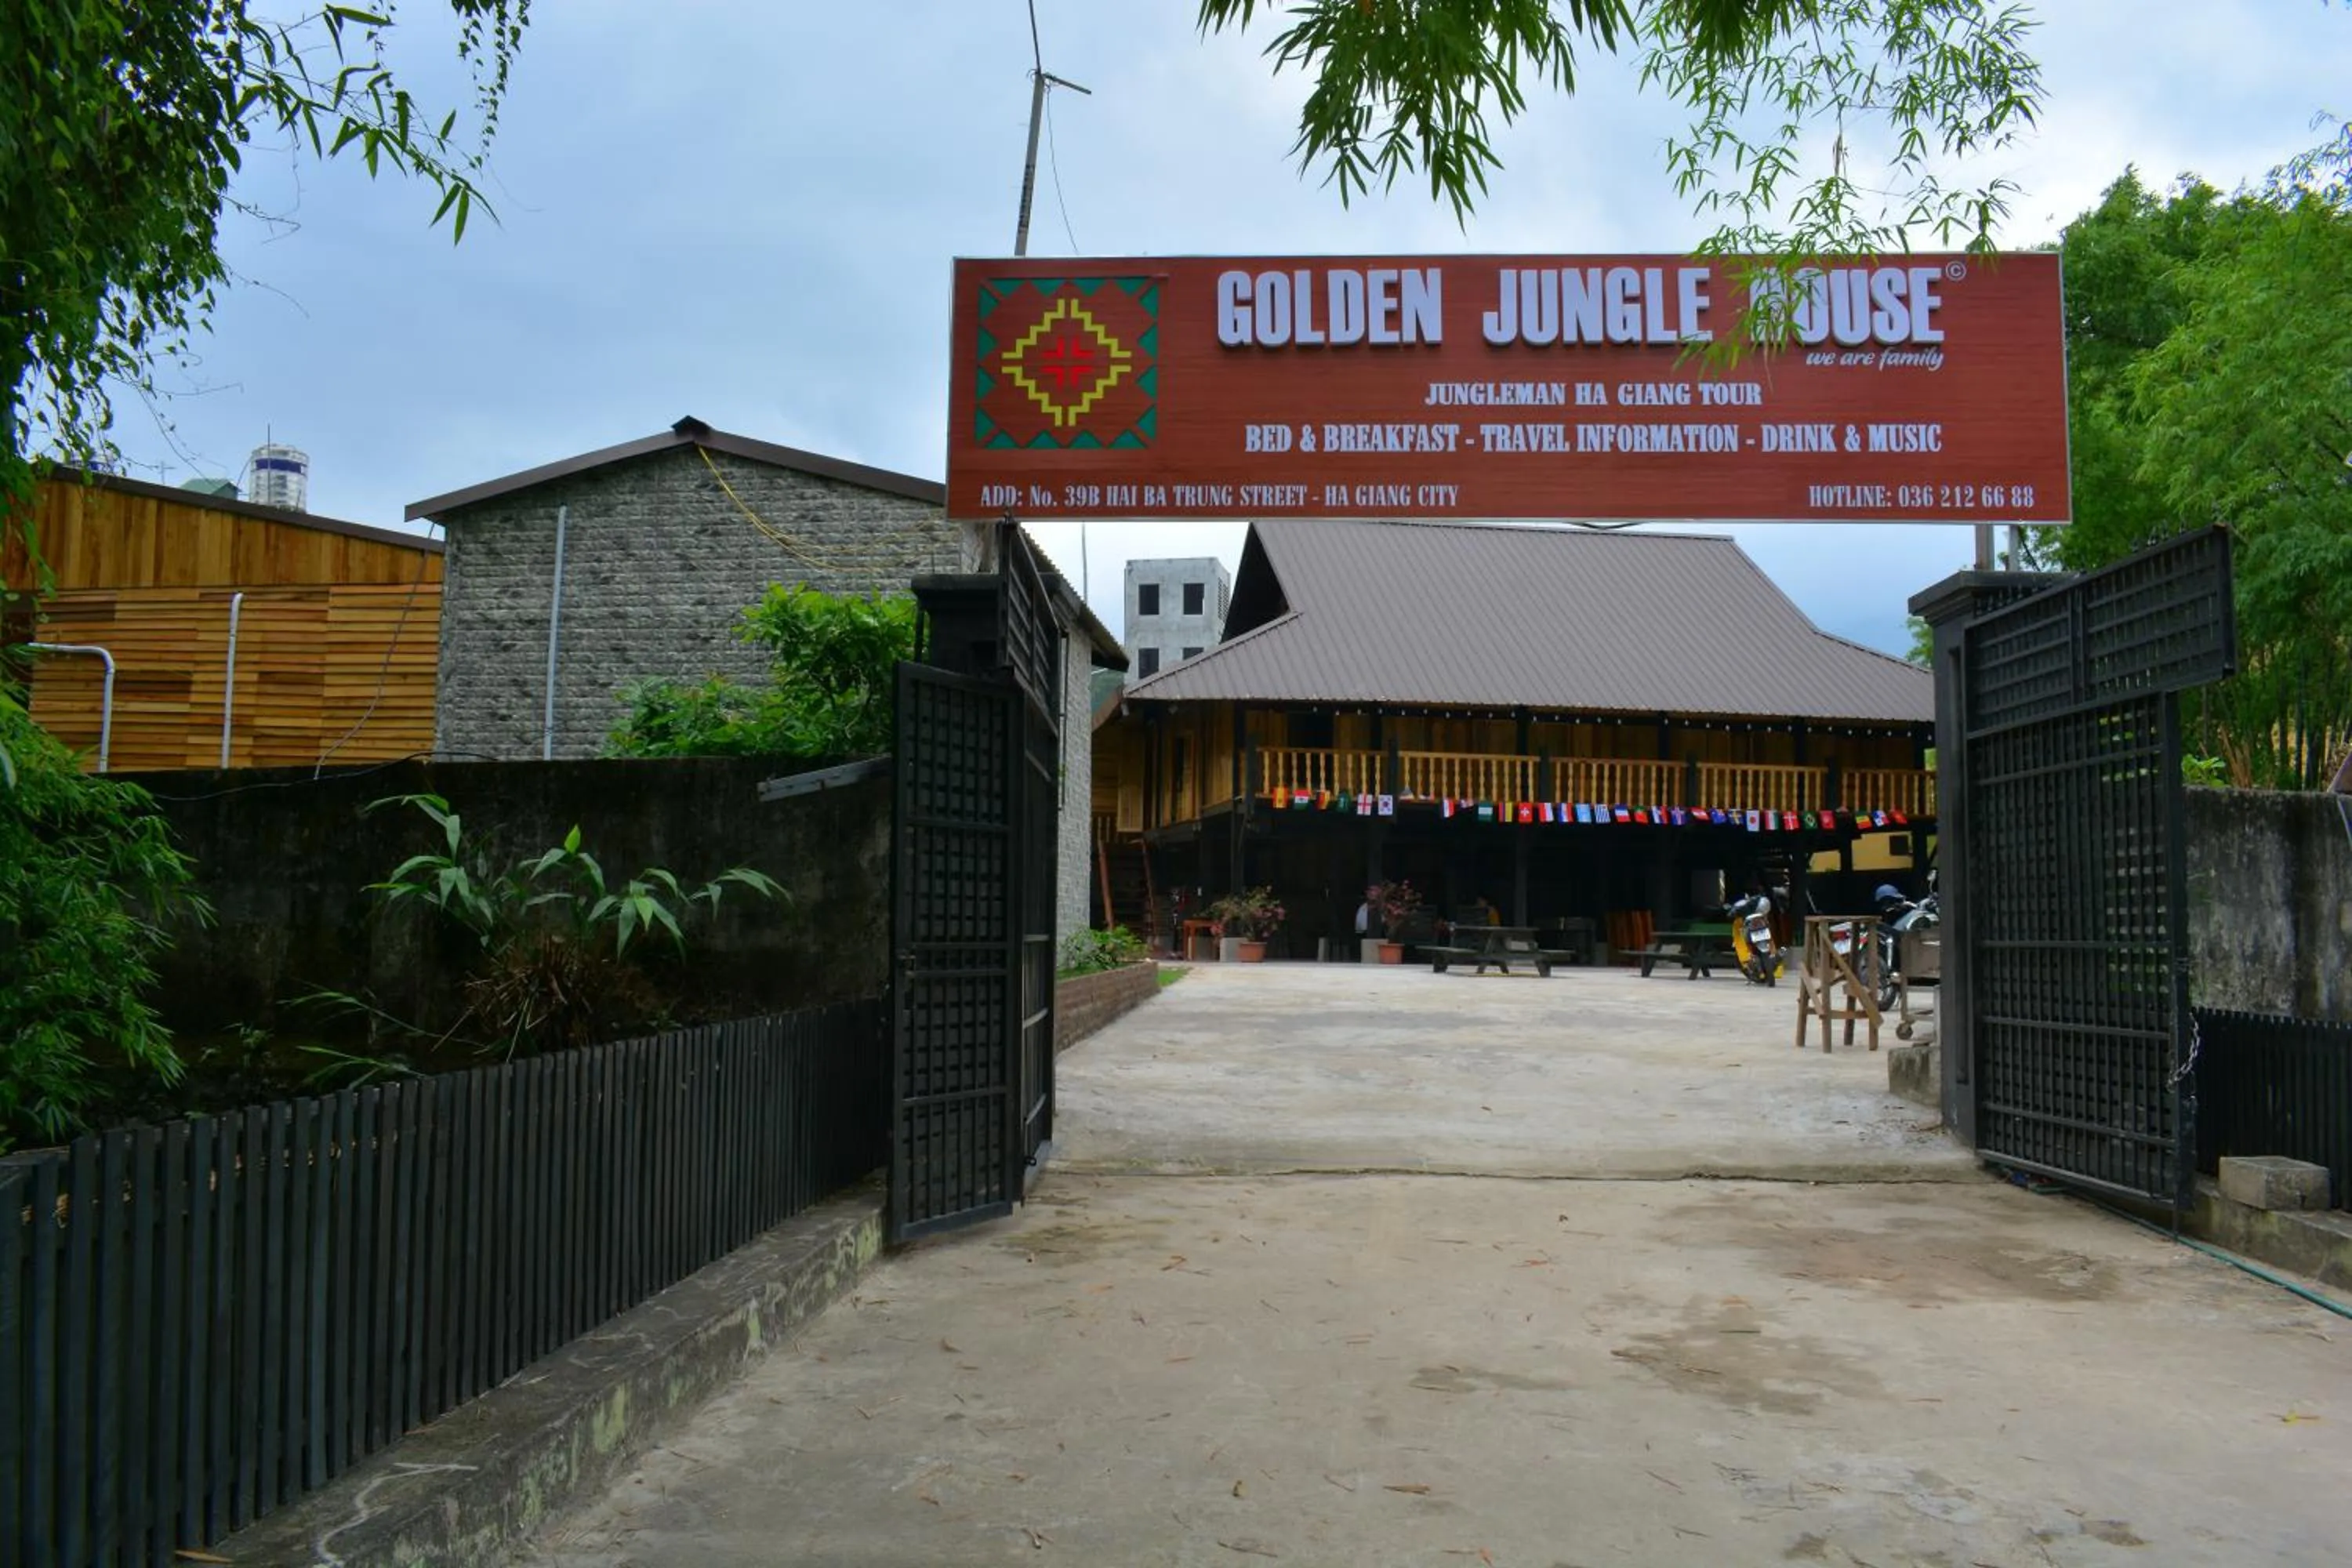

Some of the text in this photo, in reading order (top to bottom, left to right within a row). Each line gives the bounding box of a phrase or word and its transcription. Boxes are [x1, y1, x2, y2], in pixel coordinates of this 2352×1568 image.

[1216, 267, 1443, 347] GOLDEN
[1482, 266, 1714, 346] JUNGLE
[1806, 347, 1944, 372] we are family
[1425, 382, 1763, 406] JUNGLEMAN HA GIANG TOUR
[1245, 424, 1293, 453] BED
[1300, 424, 1317, 452] &
[1323, 424, 1461, 453] BREAKFAST
[1479, 424, 1570, 453] TRAVEL
[1576, 424, 1740, 453] INFORMATION
[1761, 423, 1837, 453] DRINK
[1844, 424, 1861, 452] &
[1867, 423, 1943, 453] MUSIC
[980, 485, 1022, 507] ADD:
[1029, 485, 1058, 506] No.
[1064, 485, 1100, 506] 39B
[1106, 485, 1137, 506] HAI
[1143, 485, 1167, 506] BA
[1173, 485, 1232, 507] TRUNG
[1240, 485, 1308, 507] STREET
[1324, 485, 1349, 506] HA
[1355, 485, 1412, 507] GIANG
[1417, 485, 1459, 506] CITY
[1809, 485, 2034, 508] HOTLINE: 036 212 66 88
